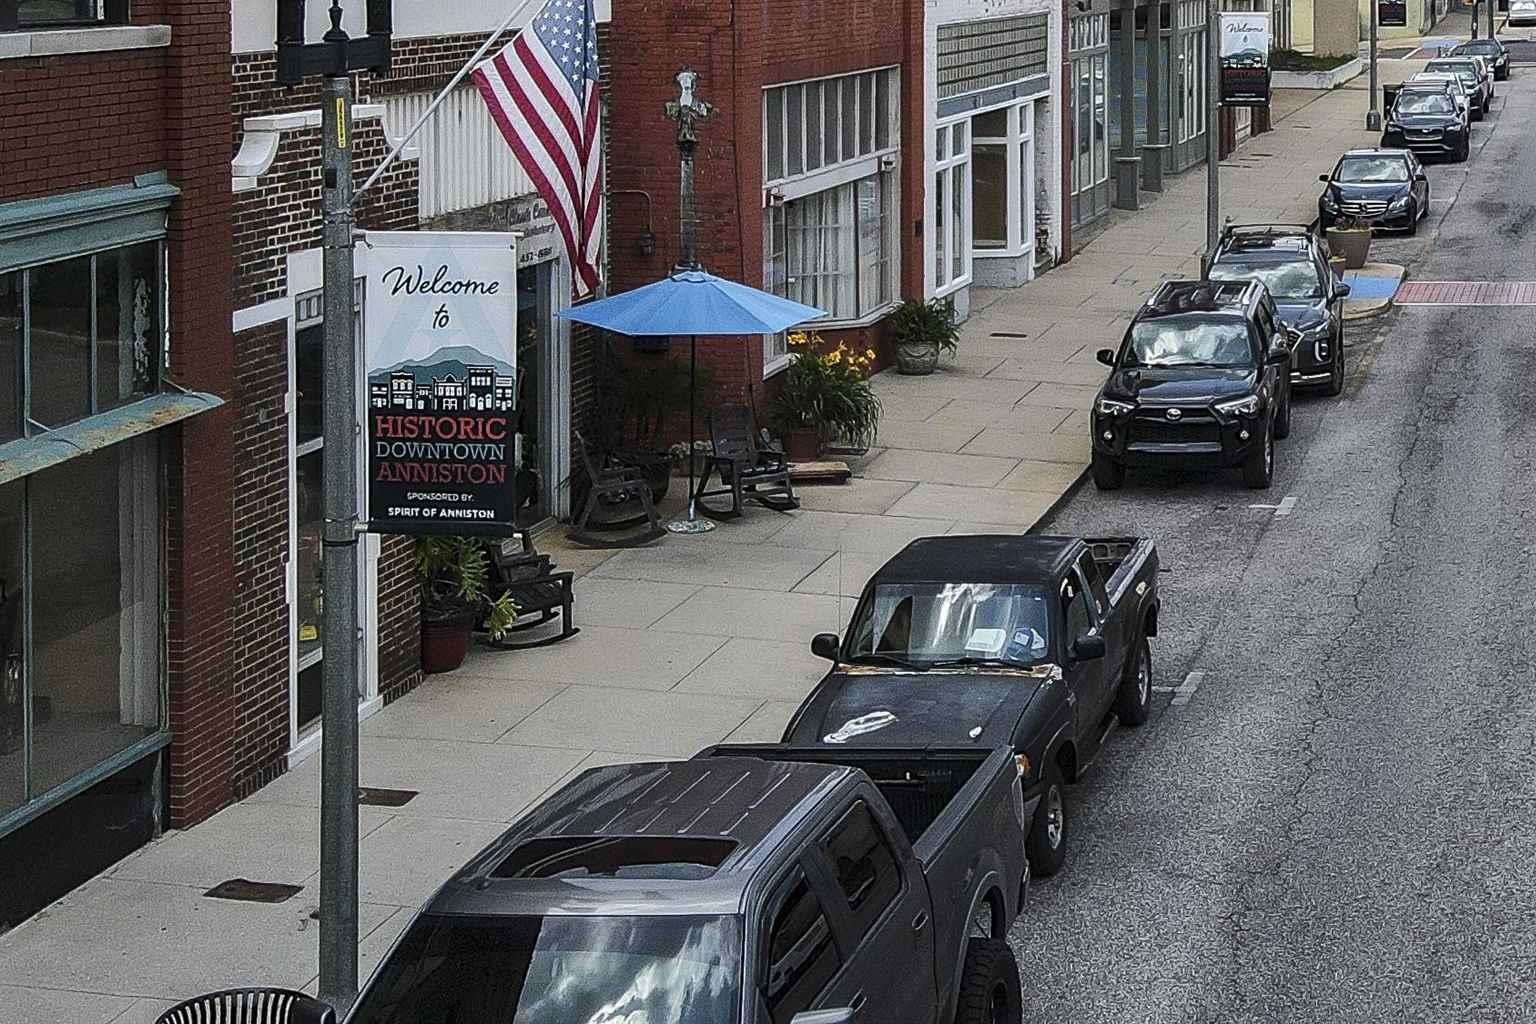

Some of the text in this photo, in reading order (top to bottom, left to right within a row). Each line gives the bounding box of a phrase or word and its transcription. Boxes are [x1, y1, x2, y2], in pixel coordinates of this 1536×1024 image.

[382, 265, 500, 295] Welcome
[433, 304, 450, 329] to
[375, 416, 507, 440] HISTORIC
[375, 442, 506, 460] DOWNTOWN
[375, 462, 508, 484] ANNISTON
[407, 492, 459, 502] SPONSORED
[388, 507, 495, 519] SPIRIT OF ANNISTON
